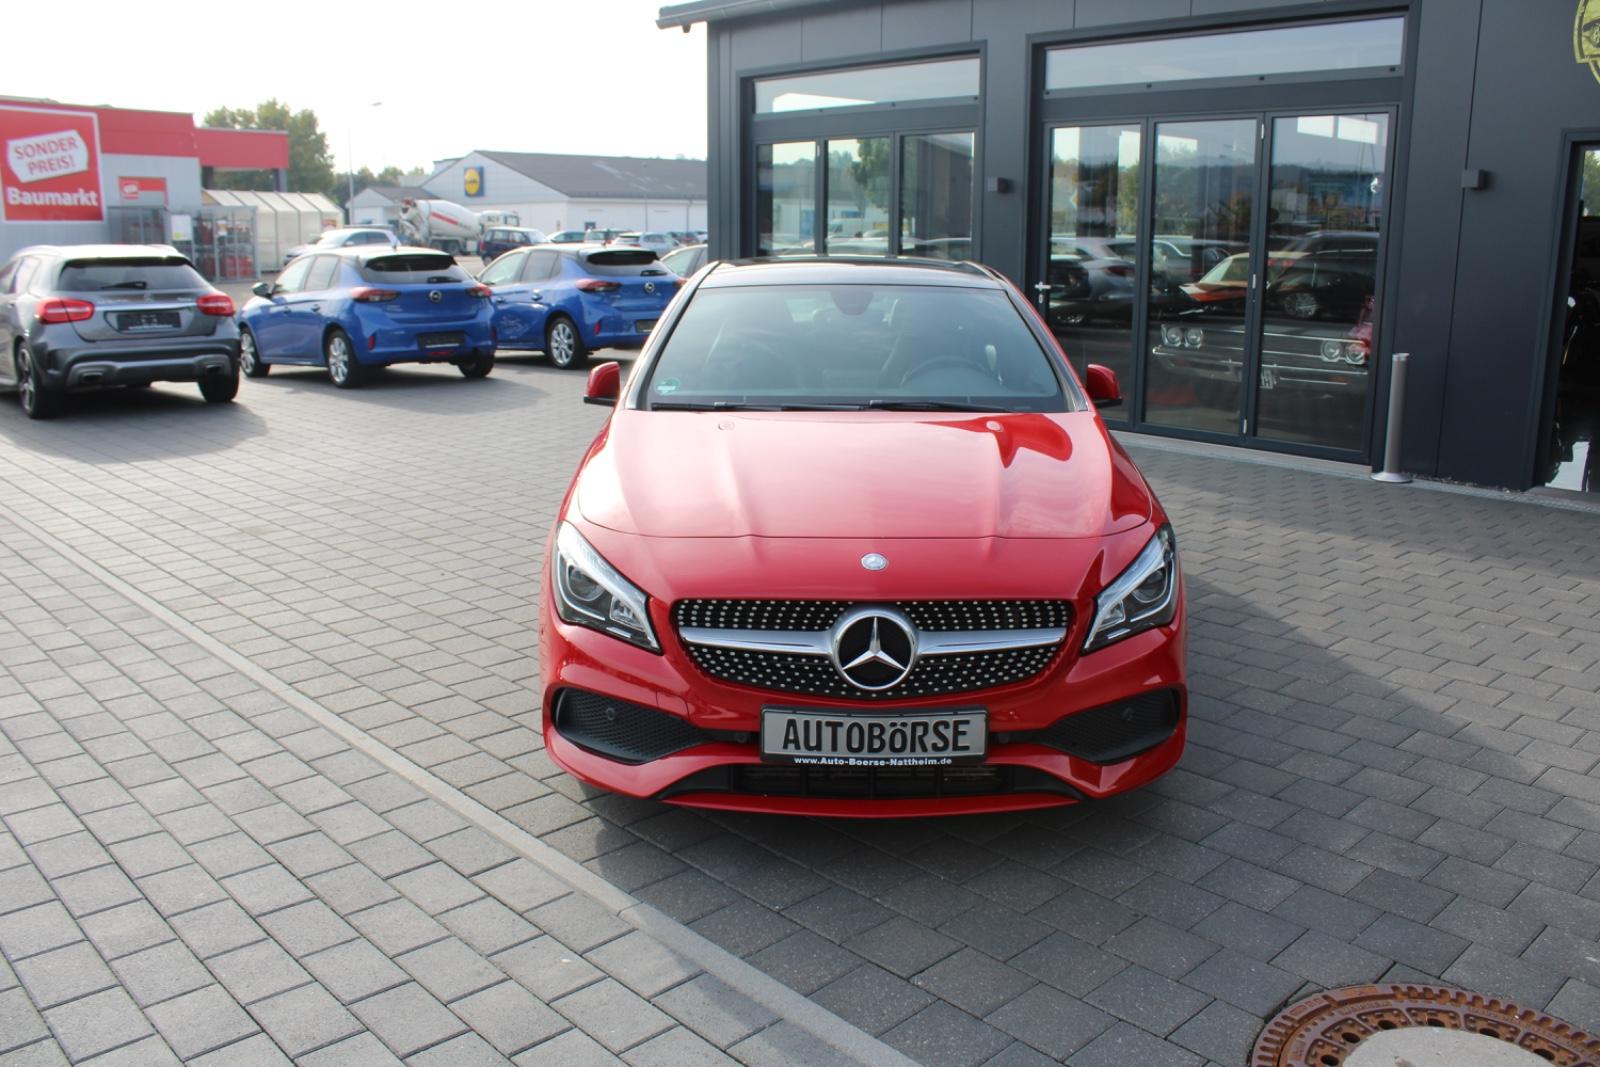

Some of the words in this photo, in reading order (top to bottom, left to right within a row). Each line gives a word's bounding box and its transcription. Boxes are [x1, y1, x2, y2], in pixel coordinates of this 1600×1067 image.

[14, 137, 79, 160] SONDER
[27, 155, 75, 176] PREIS!
[7, 186, 98, 206] Baumarkt
[794, 756, 953, 766] www.Auto-Boerse-Nattheim.de
